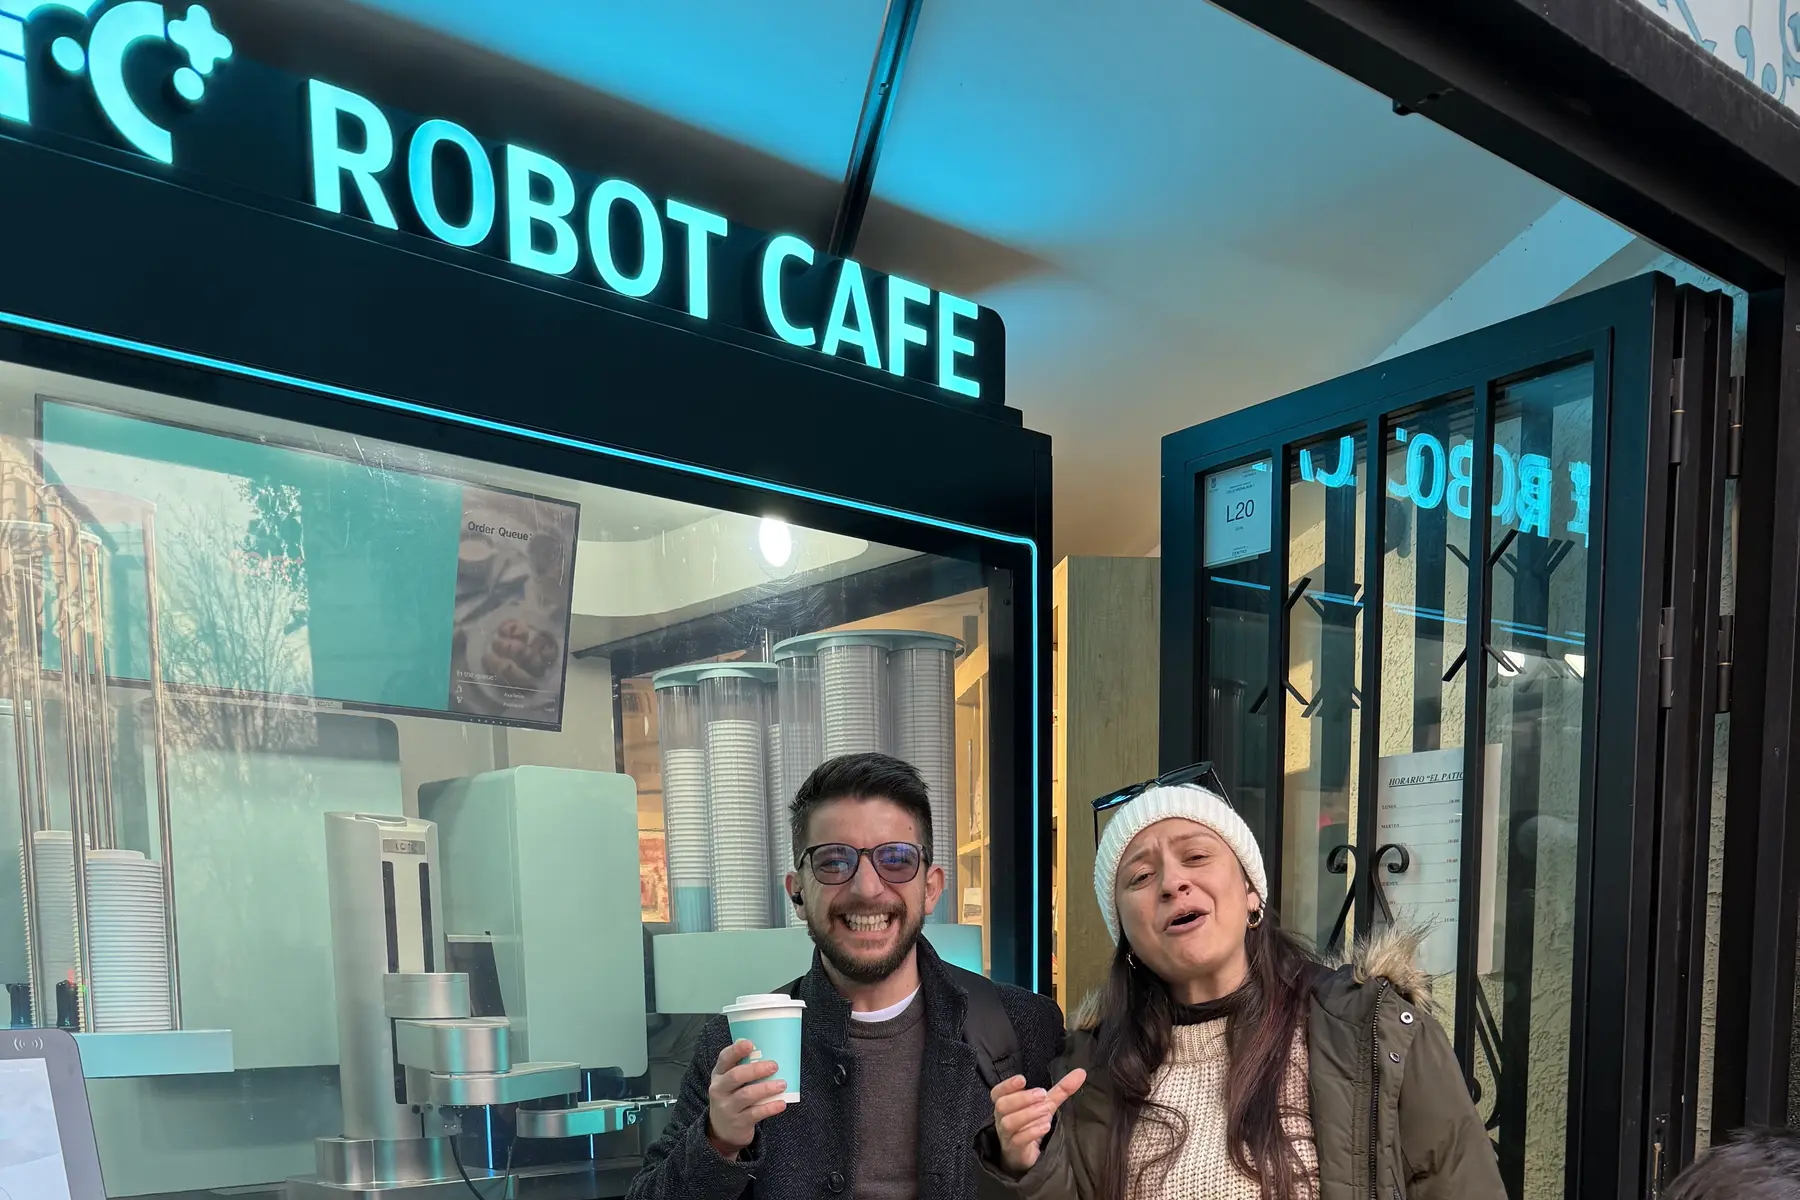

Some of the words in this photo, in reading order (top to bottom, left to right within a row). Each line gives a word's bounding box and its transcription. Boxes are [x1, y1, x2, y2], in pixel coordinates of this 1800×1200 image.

[309, 78, 728, 319] ROBOT
[762, 236, 980, 398] CAFE
[1227, 499, 1255, 523] L20
[468, 521, 495, 534] Order
[498, 526, 532, 541] Queue:
[1389, 775, 1425, 786] HORARIO
